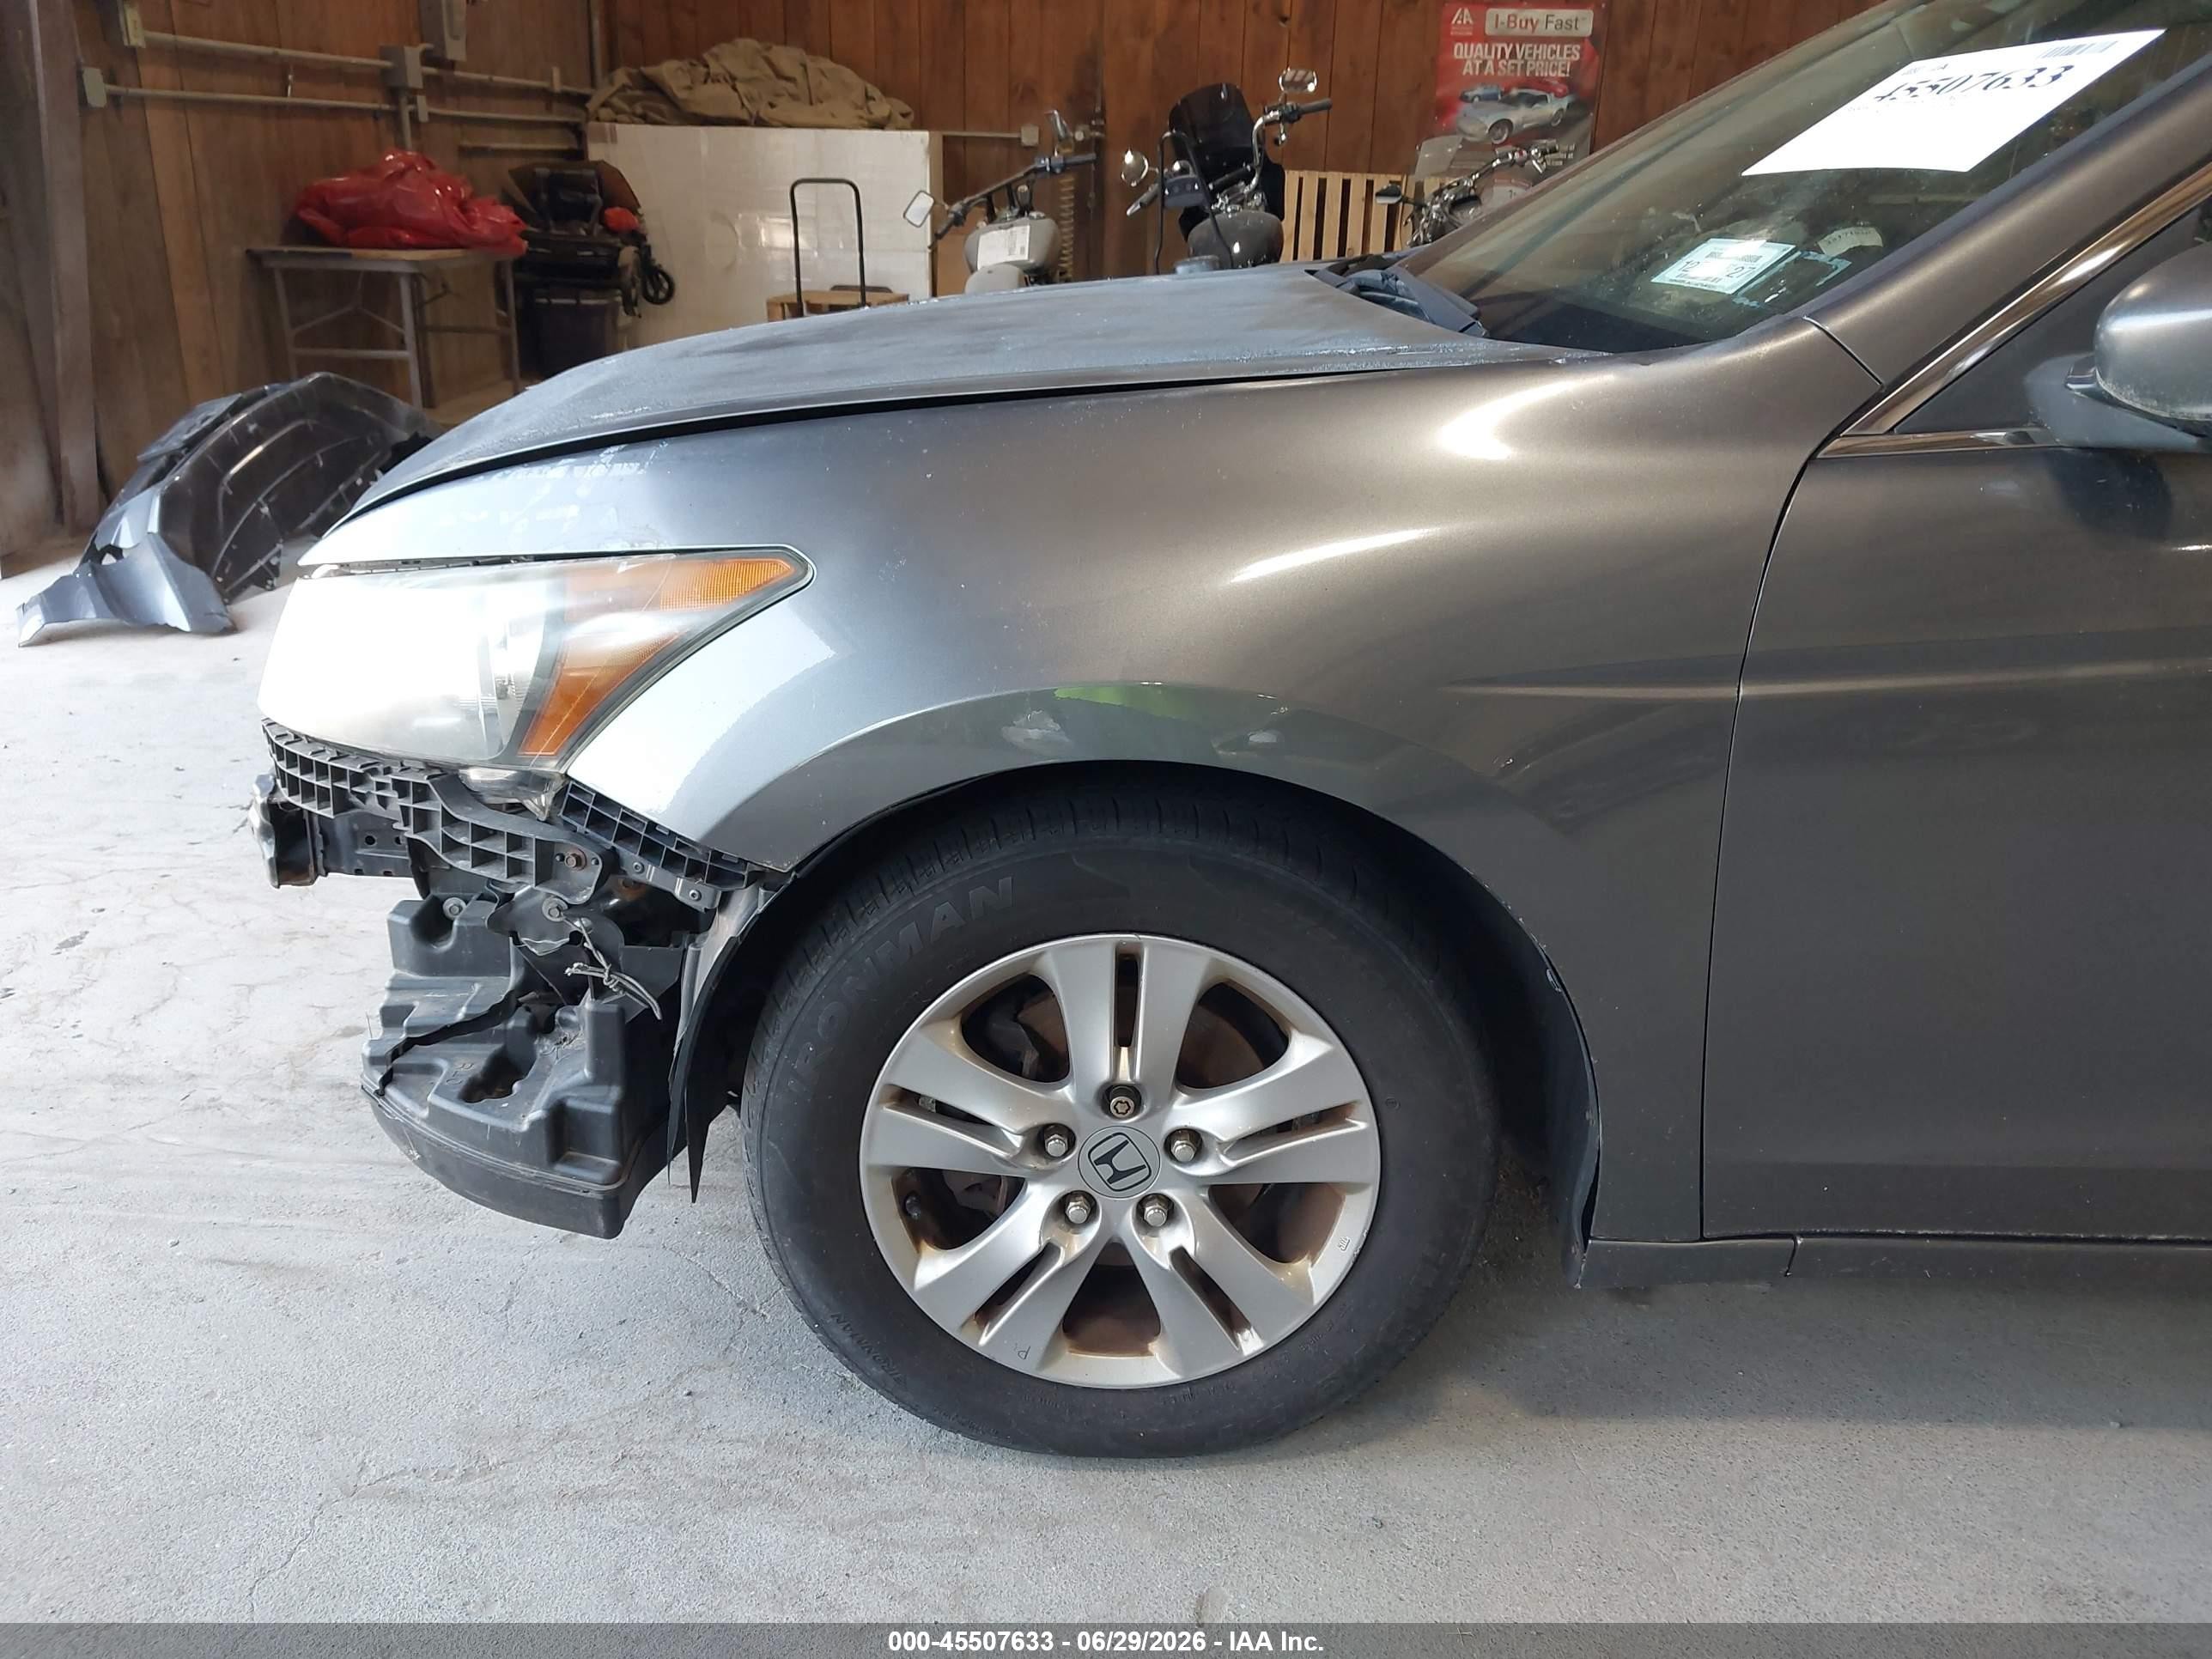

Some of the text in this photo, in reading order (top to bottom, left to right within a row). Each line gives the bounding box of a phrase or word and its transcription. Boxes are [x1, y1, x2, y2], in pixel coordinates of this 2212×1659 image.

[1494, 14, 1539, 33] I-Buy
[1454, 43, 1581, 61] QUALITY VEHICLES
[1462, 60, 1571, 77] AT A SET PRICE!
[1874, 64, 2075, 101] 45507633
